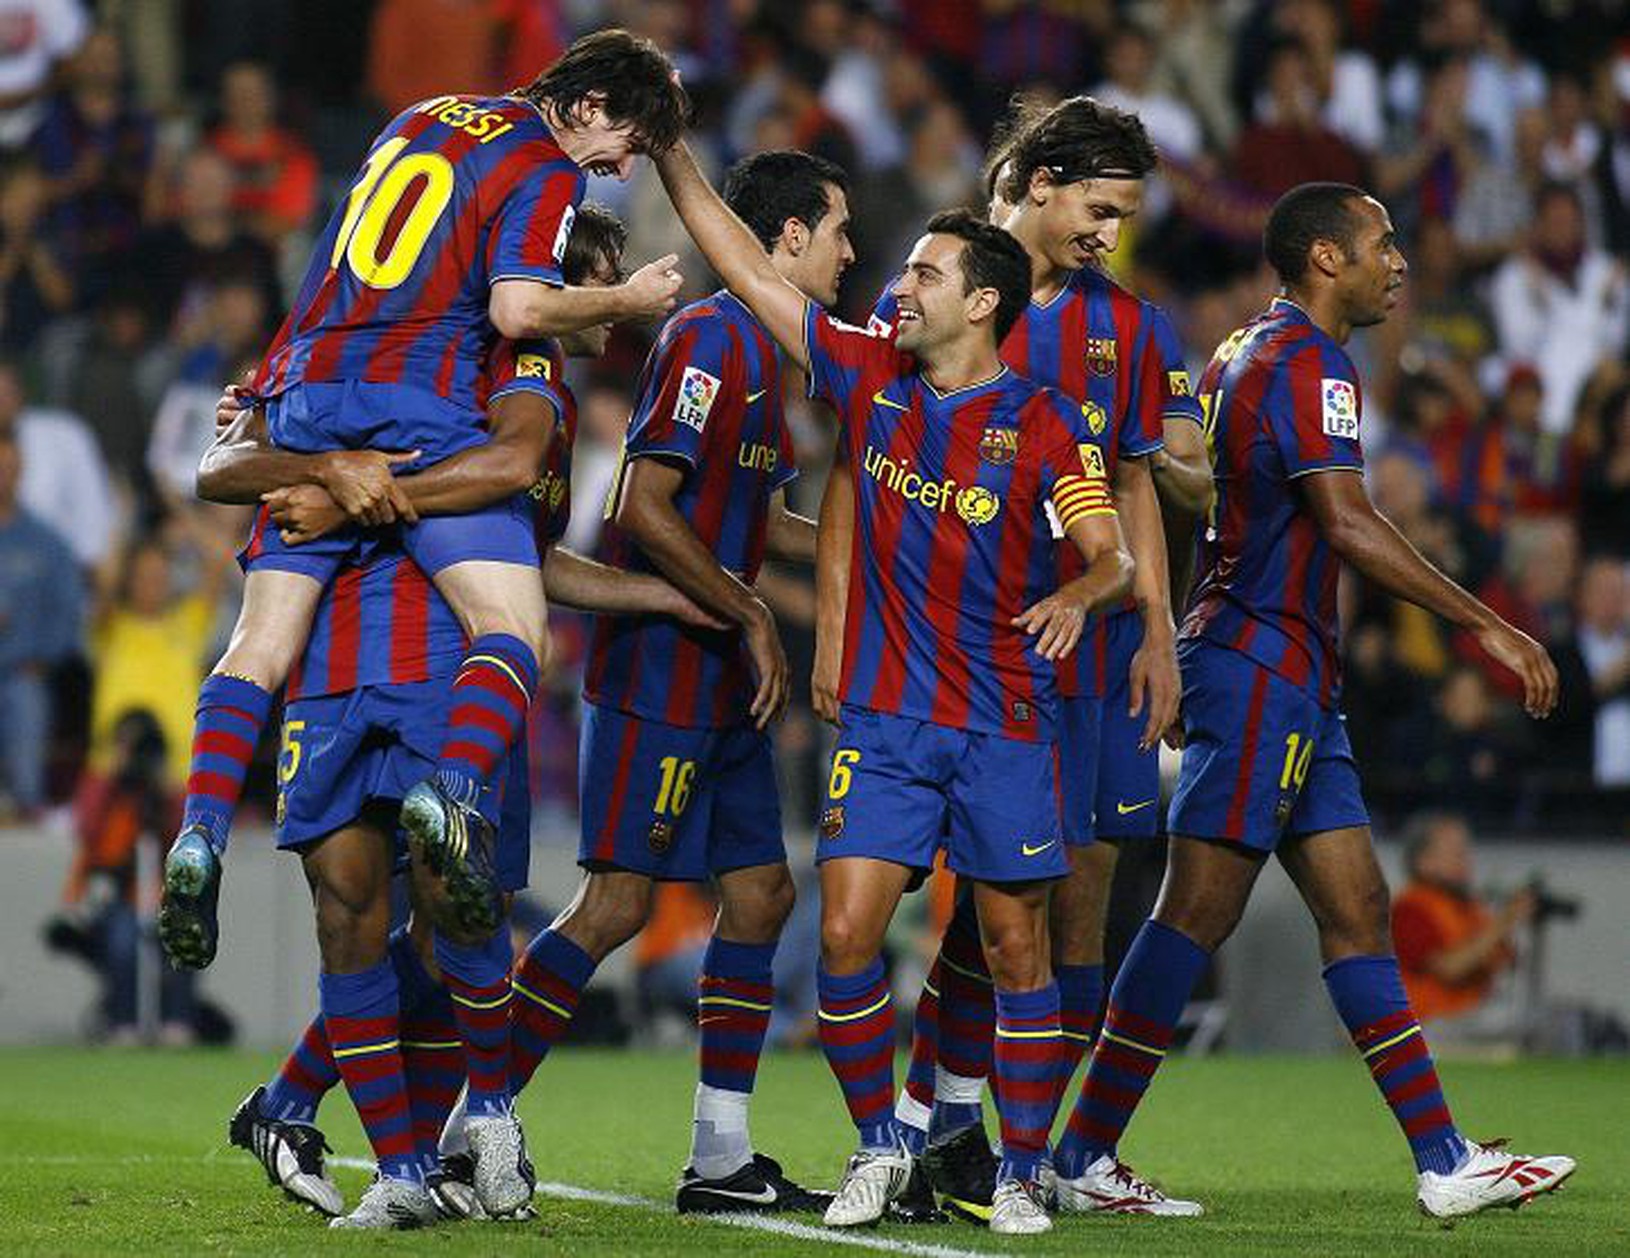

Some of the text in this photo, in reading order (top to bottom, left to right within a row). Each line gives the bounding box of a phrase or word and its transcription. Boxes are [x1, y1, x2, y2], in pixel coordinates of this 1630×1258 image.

[331, 136, 455, 289] 10
[678, 403, 704, 426] LFP
[1328, 416, 1356, 435] LFP
[864, 446, 957, 513] unicef
[653, 756, 696, 817] 16
[829, 749, 862, 799] 6
